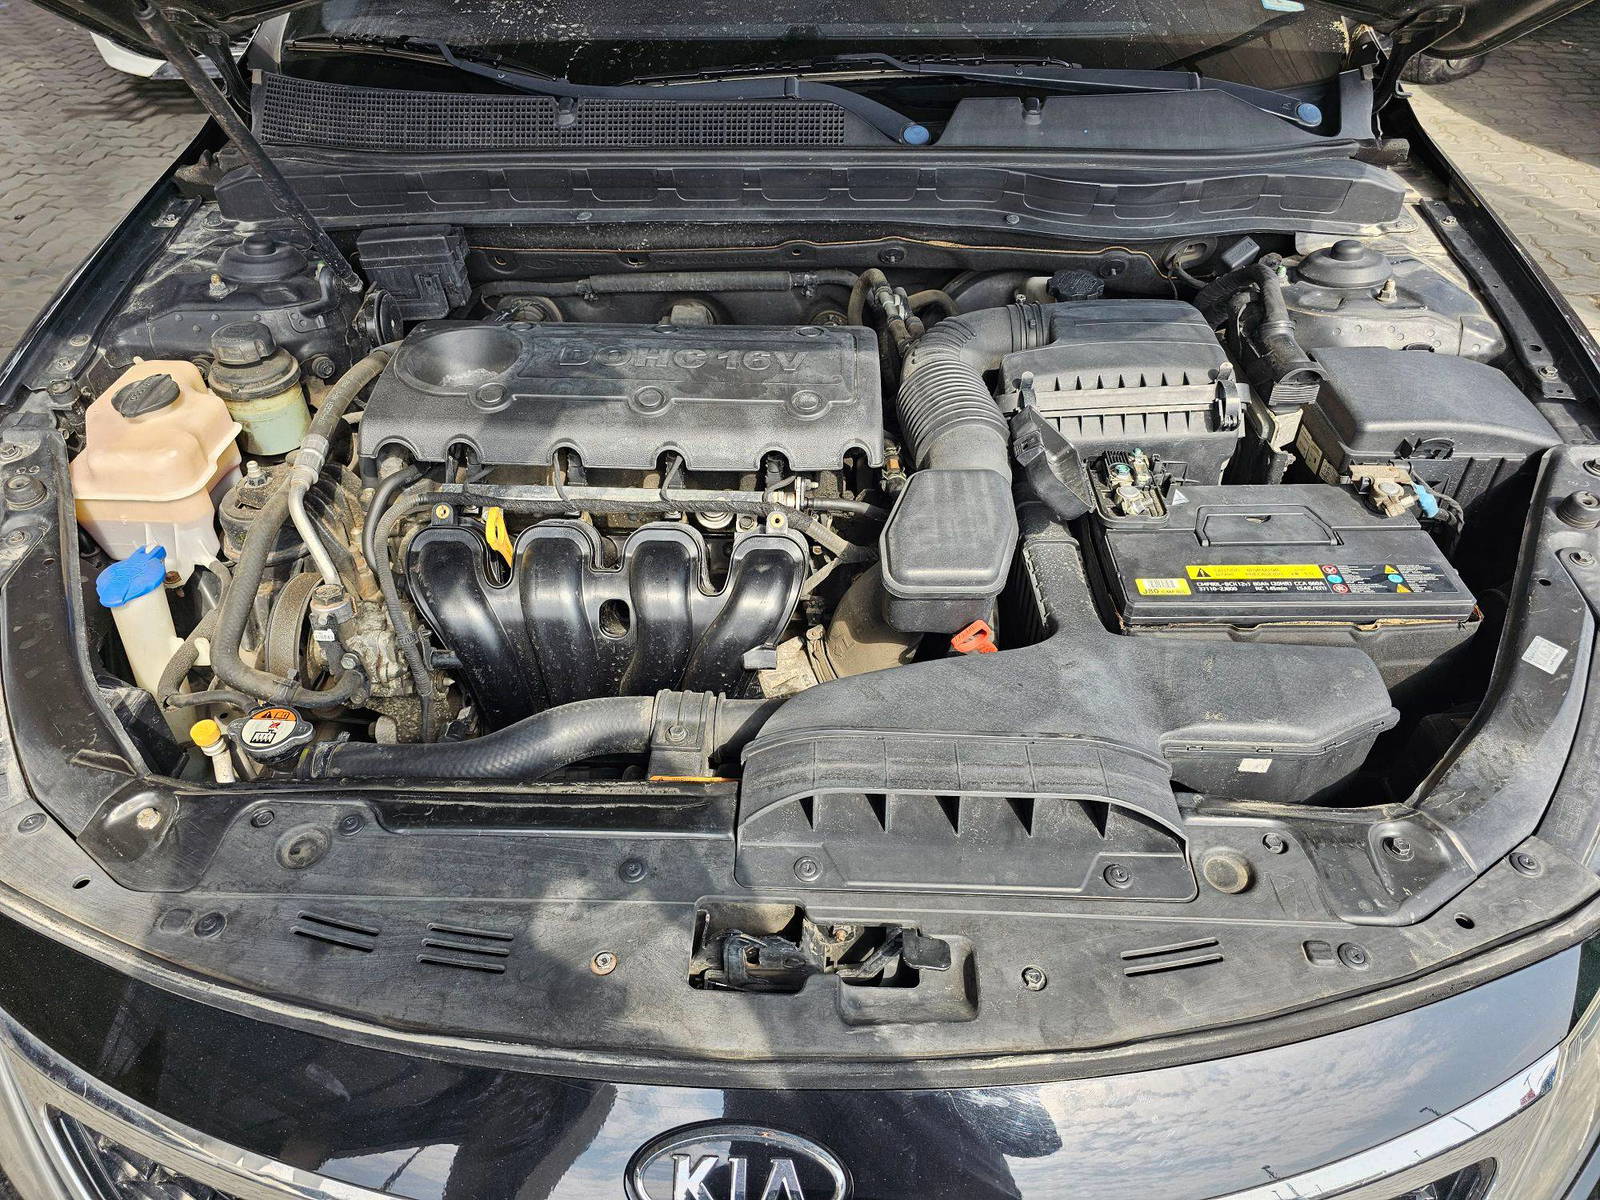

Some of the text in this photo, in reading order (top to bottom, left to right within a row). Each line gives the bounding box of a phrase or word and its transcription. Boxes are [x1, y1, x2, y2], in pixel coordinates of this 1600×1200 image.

[560, 345, 808, 371] DOHC 16V
[672, 1153, 805, 1200] KIA
